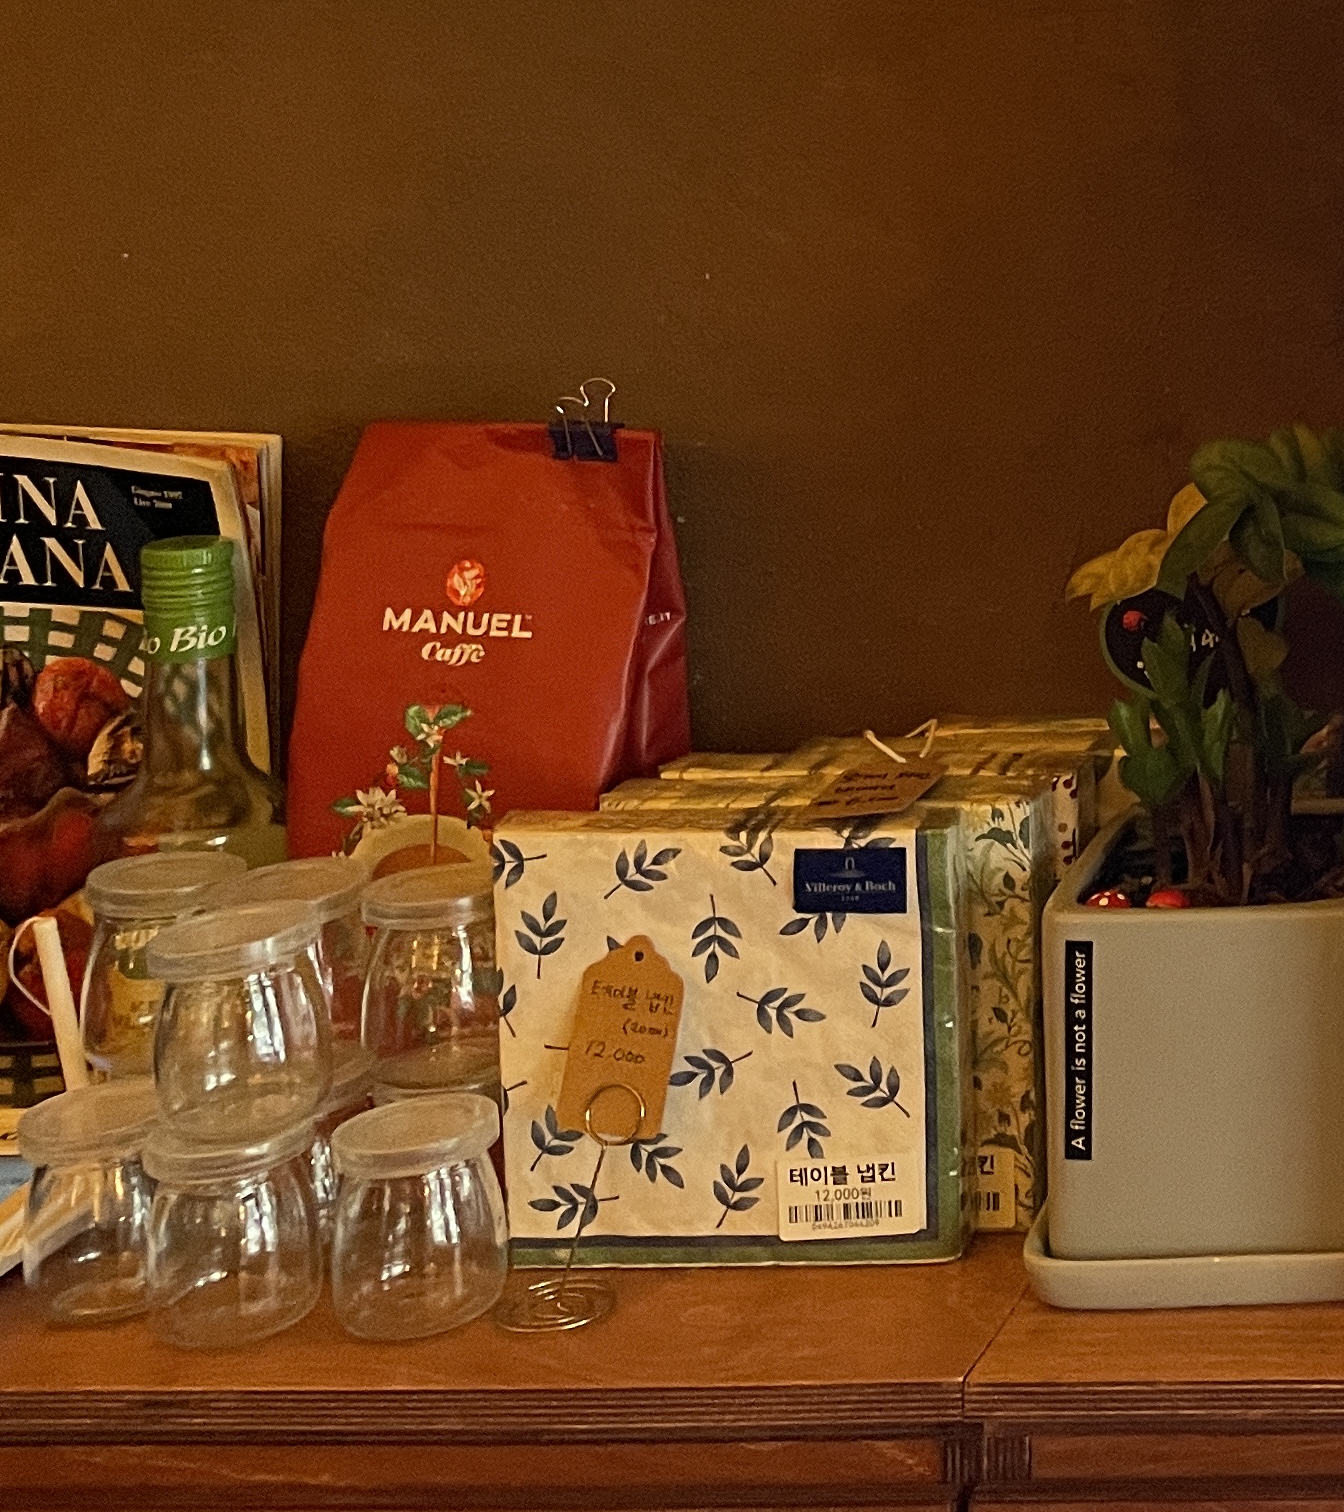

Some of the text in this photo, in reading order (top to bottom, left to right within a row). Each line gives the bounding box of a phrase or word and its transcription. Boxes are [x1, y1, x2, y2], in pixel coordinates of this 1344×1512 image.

[382, 606, 533, 639] MANUEL
[170, 624, 227, 653] Bio
[804, 880, 852, 893] Villeroy
[865, 879, 896, 892] Boch
[1069, 950, 1087, 1152] A flower is not a flower
[788, 1161, 897, 1187] 테이블 냅킨
